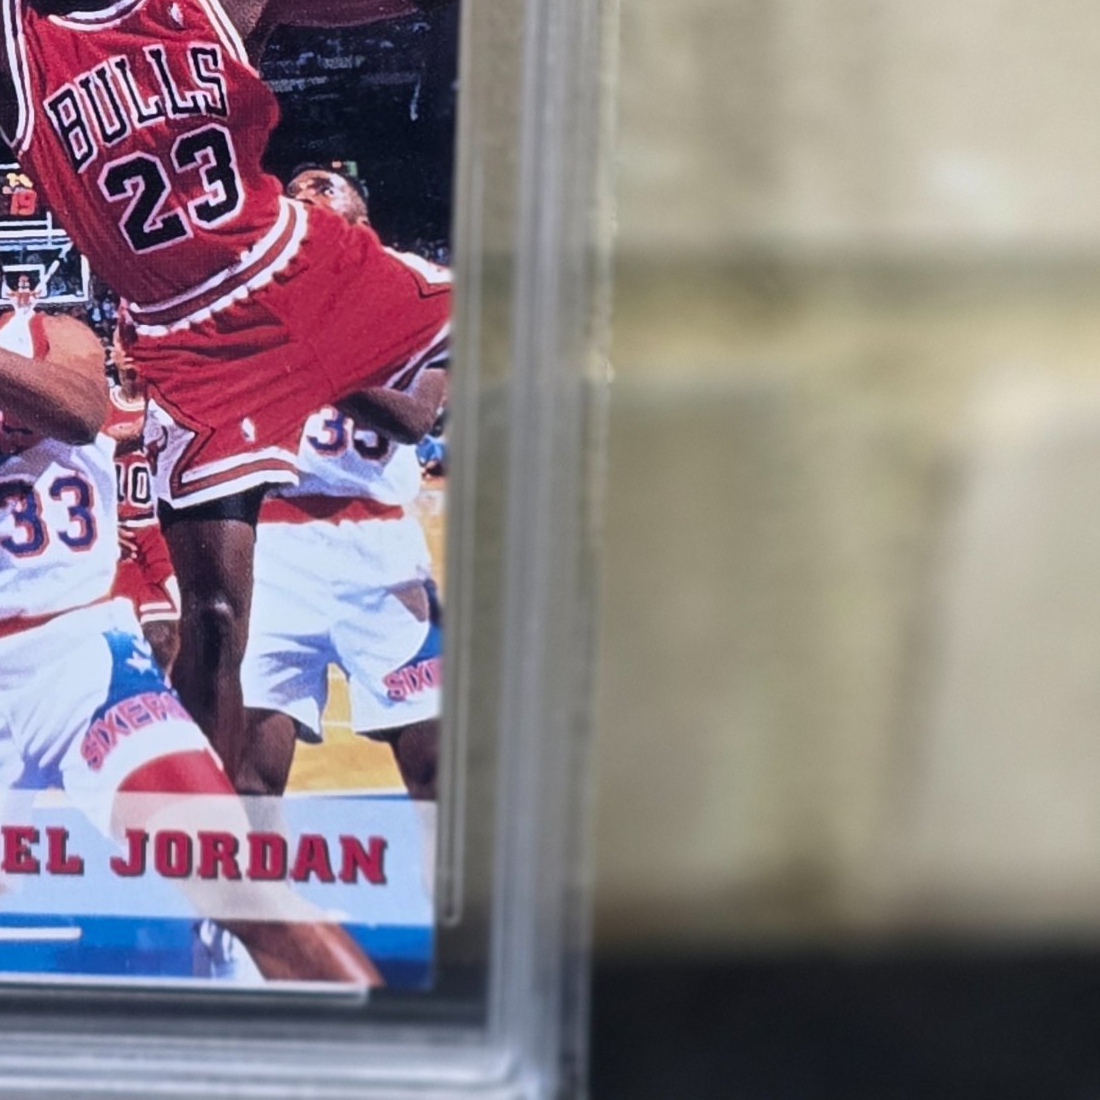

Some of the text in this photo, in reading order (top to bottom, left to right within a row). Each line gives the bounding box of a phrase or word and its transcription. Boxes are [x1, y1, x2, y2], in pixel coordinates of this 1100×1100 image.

[43, 41, 230, 174] BULLS
[97, 122, 246, 255] 23
[109, 827, 389, 886] JORDAN
